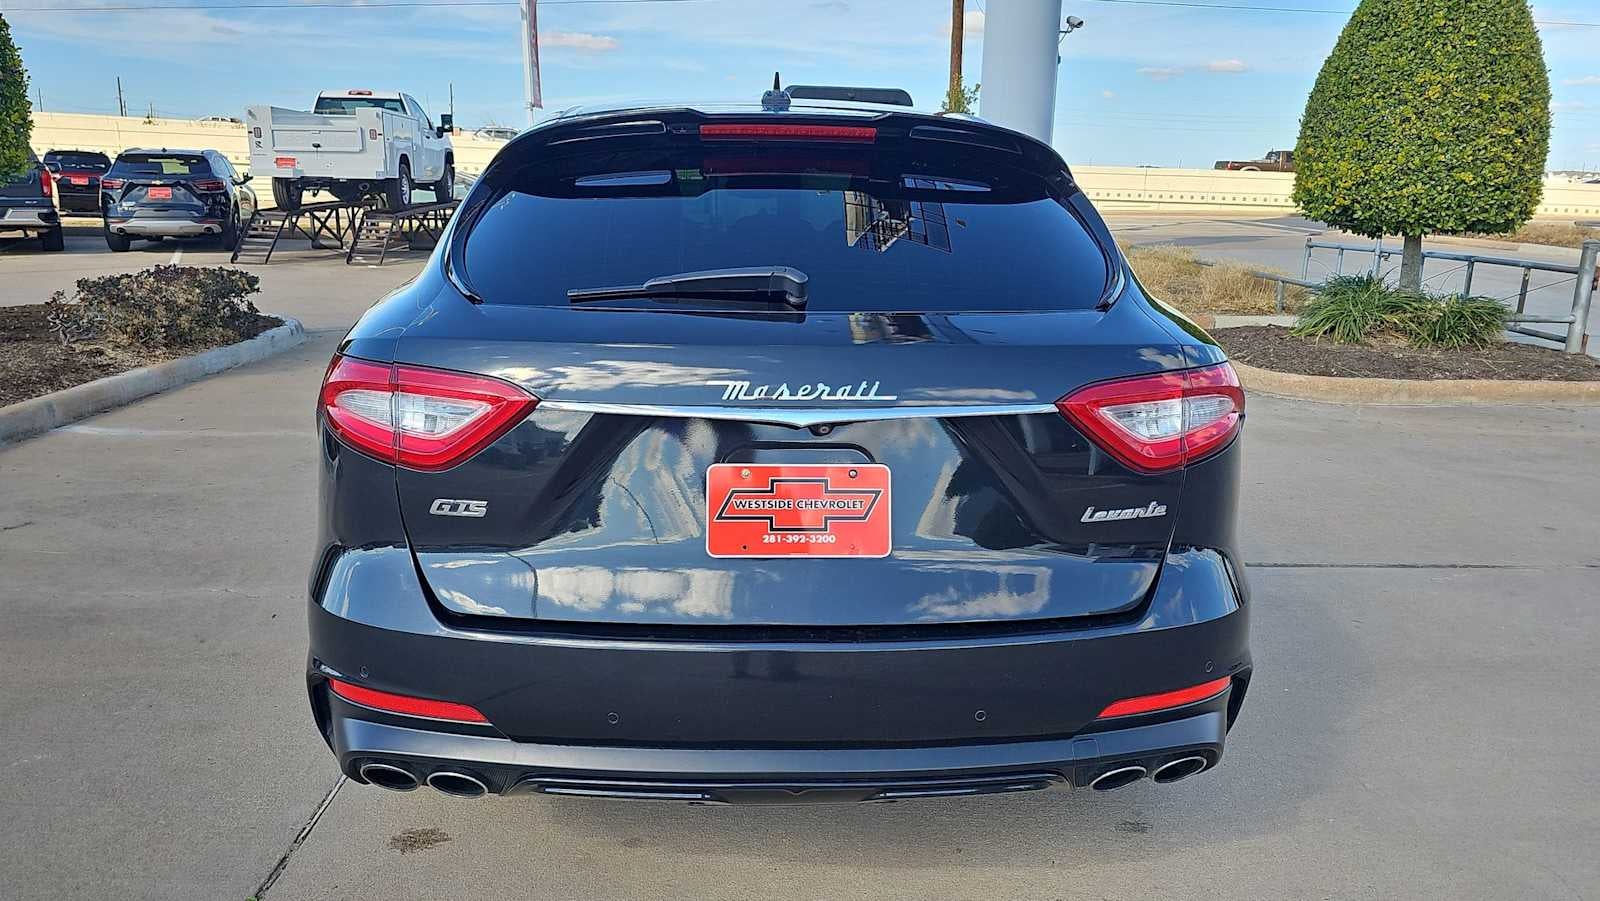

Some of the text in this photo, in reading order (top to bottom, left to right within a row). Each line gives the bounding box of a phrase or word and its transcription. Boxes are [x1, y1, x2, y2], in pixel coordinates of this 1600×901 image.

[706, 380, 898, 400] Maserati
[429, 498, 488, 517] GTS
[734, 499, 865, 509] WESTSIDE CHEVROLET
[1080, 501, 1167, 522] Levante
[762, 534, 836, 544] 281-392-3200
